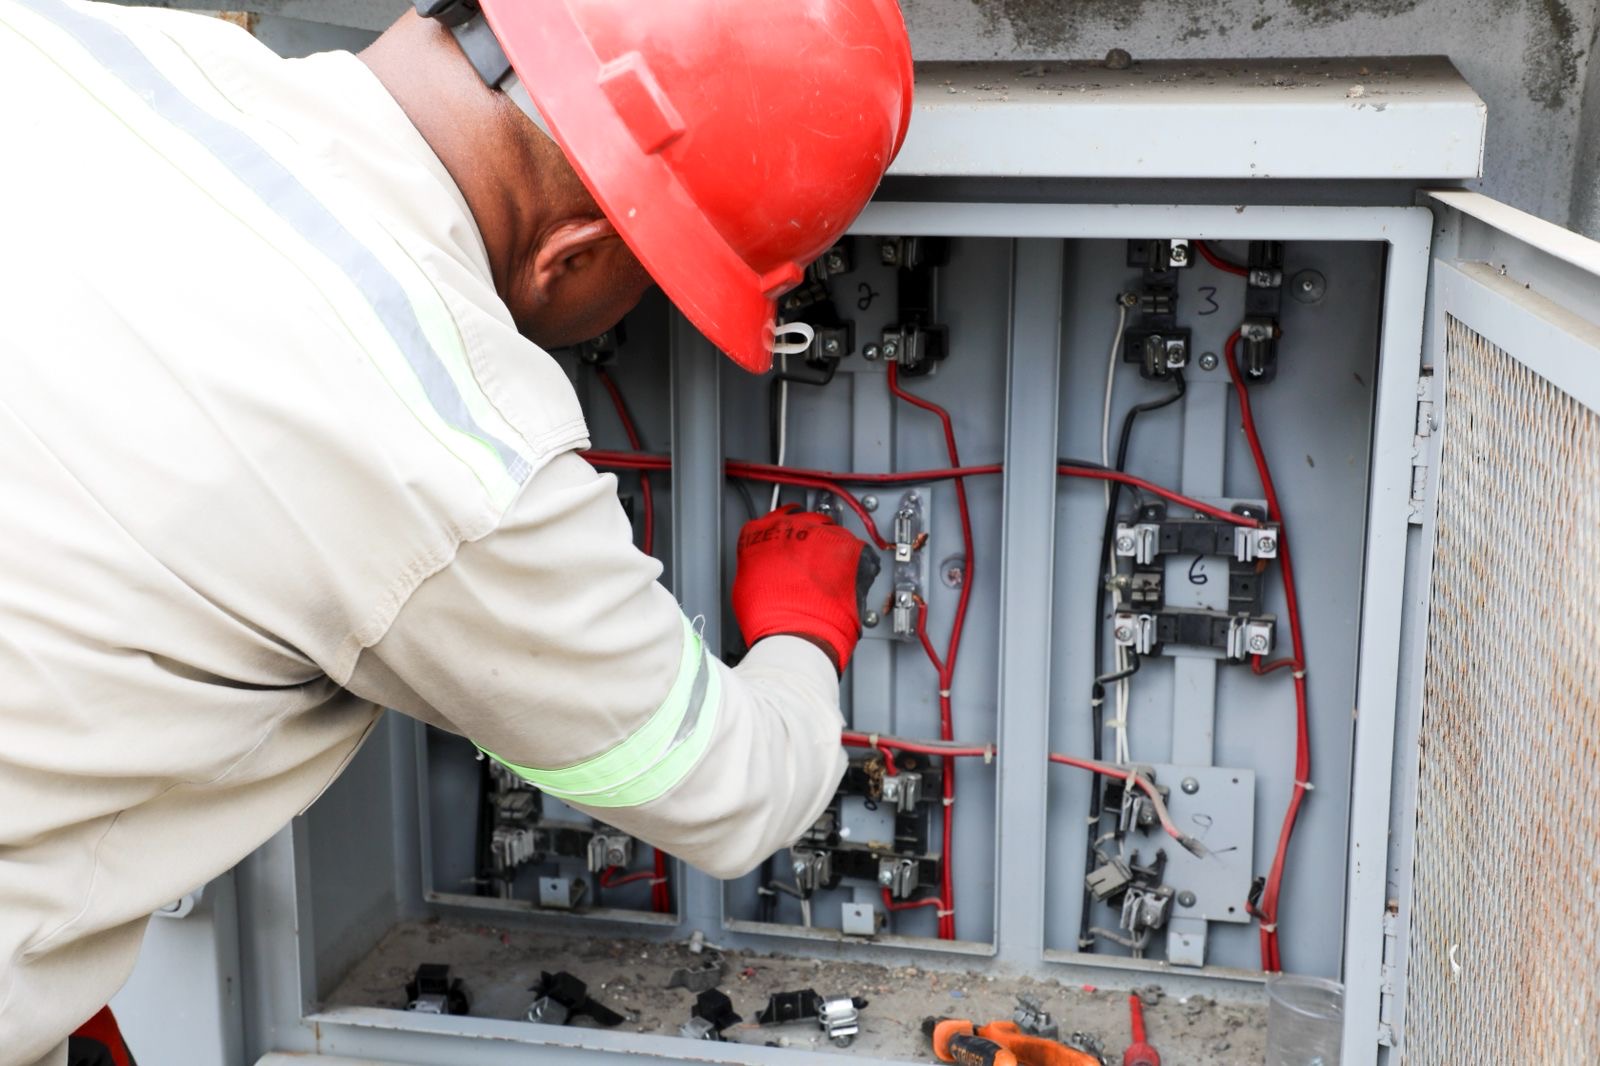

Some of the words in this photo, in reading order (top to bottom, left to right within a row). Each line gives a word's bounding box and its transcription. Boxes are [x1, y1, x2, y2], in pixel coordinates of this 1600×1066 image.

[857, 282, 880, 311] 2
[1198, 286, 1219, 316] 3
[1188, 554, 1208, 585] 6
